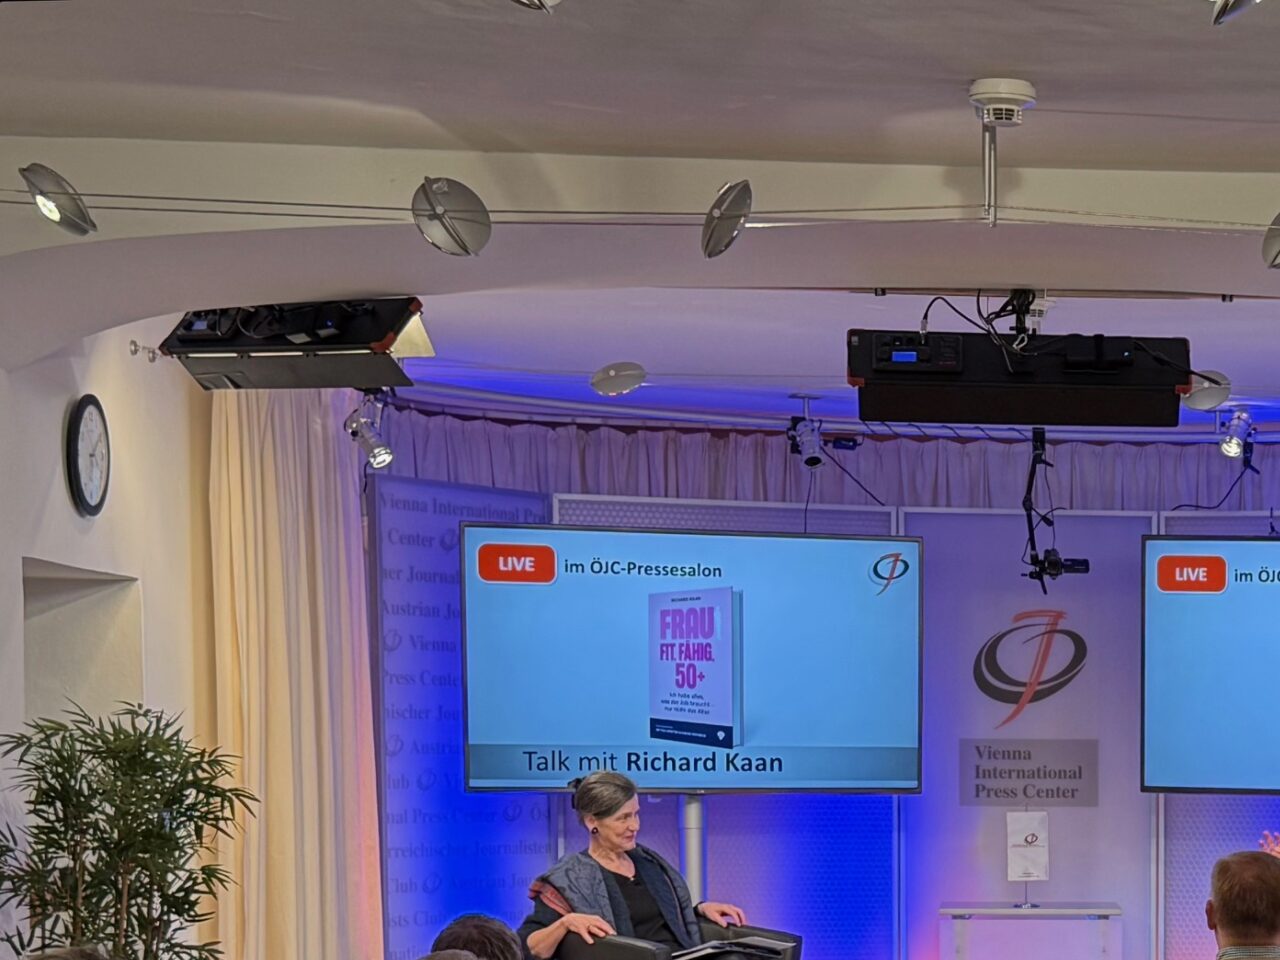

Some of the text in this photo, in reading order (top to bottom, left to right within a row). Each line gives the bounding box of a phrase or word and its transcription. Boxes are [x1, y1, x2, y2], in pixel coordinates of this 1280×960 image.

[433, 498, 519, 521] International
[388, 528, 435, 548] Center
[498, 556, 535, 572] LIVE
[564, 557, 722, 578] im ÖJC-Pressesalon
[1175, 567, 1208, 582] LIVE
[1234, 568, 1253, 583] im
[660, 606, 715, 641] FRAU
[409, 634, 457, 653] Vienna
[660, 640, 715, 662] FIT. FÄHIG.
[675, 662, 705, 689] 50+
[522, 750, 783, 773] Talk mit Richard Kaan
[975, 745, 1032, 760] Vienna
[975, 764, 1082, 779] International
[975, 783, 1079, 799] Press Center
